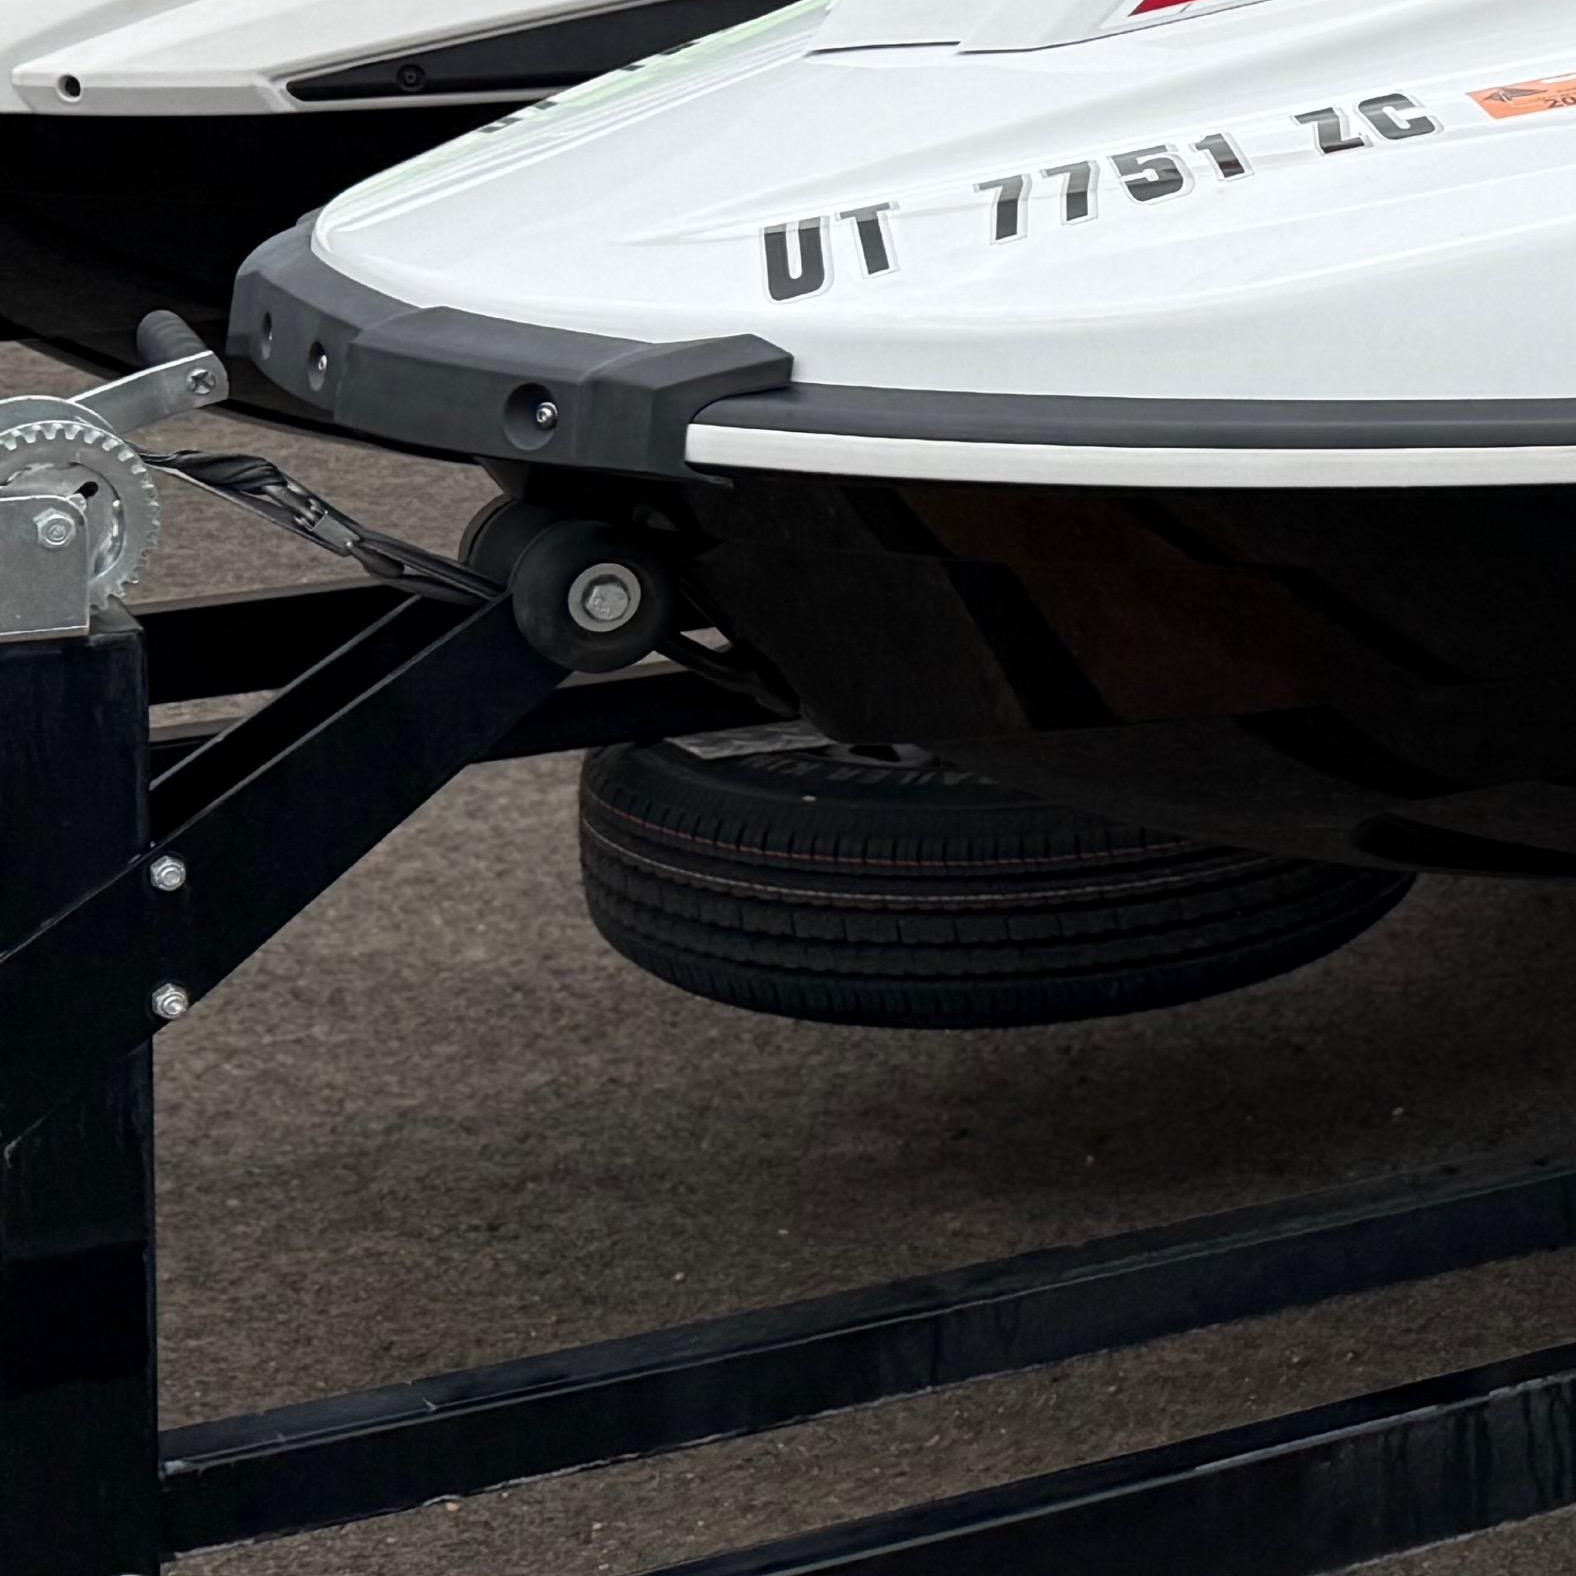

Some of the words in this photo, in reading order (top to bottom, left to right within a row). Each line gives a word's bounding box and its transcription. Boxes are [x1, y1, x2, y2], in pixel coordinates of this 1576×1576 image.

[763, 200, 899, 303] UT
[975, 131, 1256, 243] 7751
[1294, 91, 1444, 157] ZC
